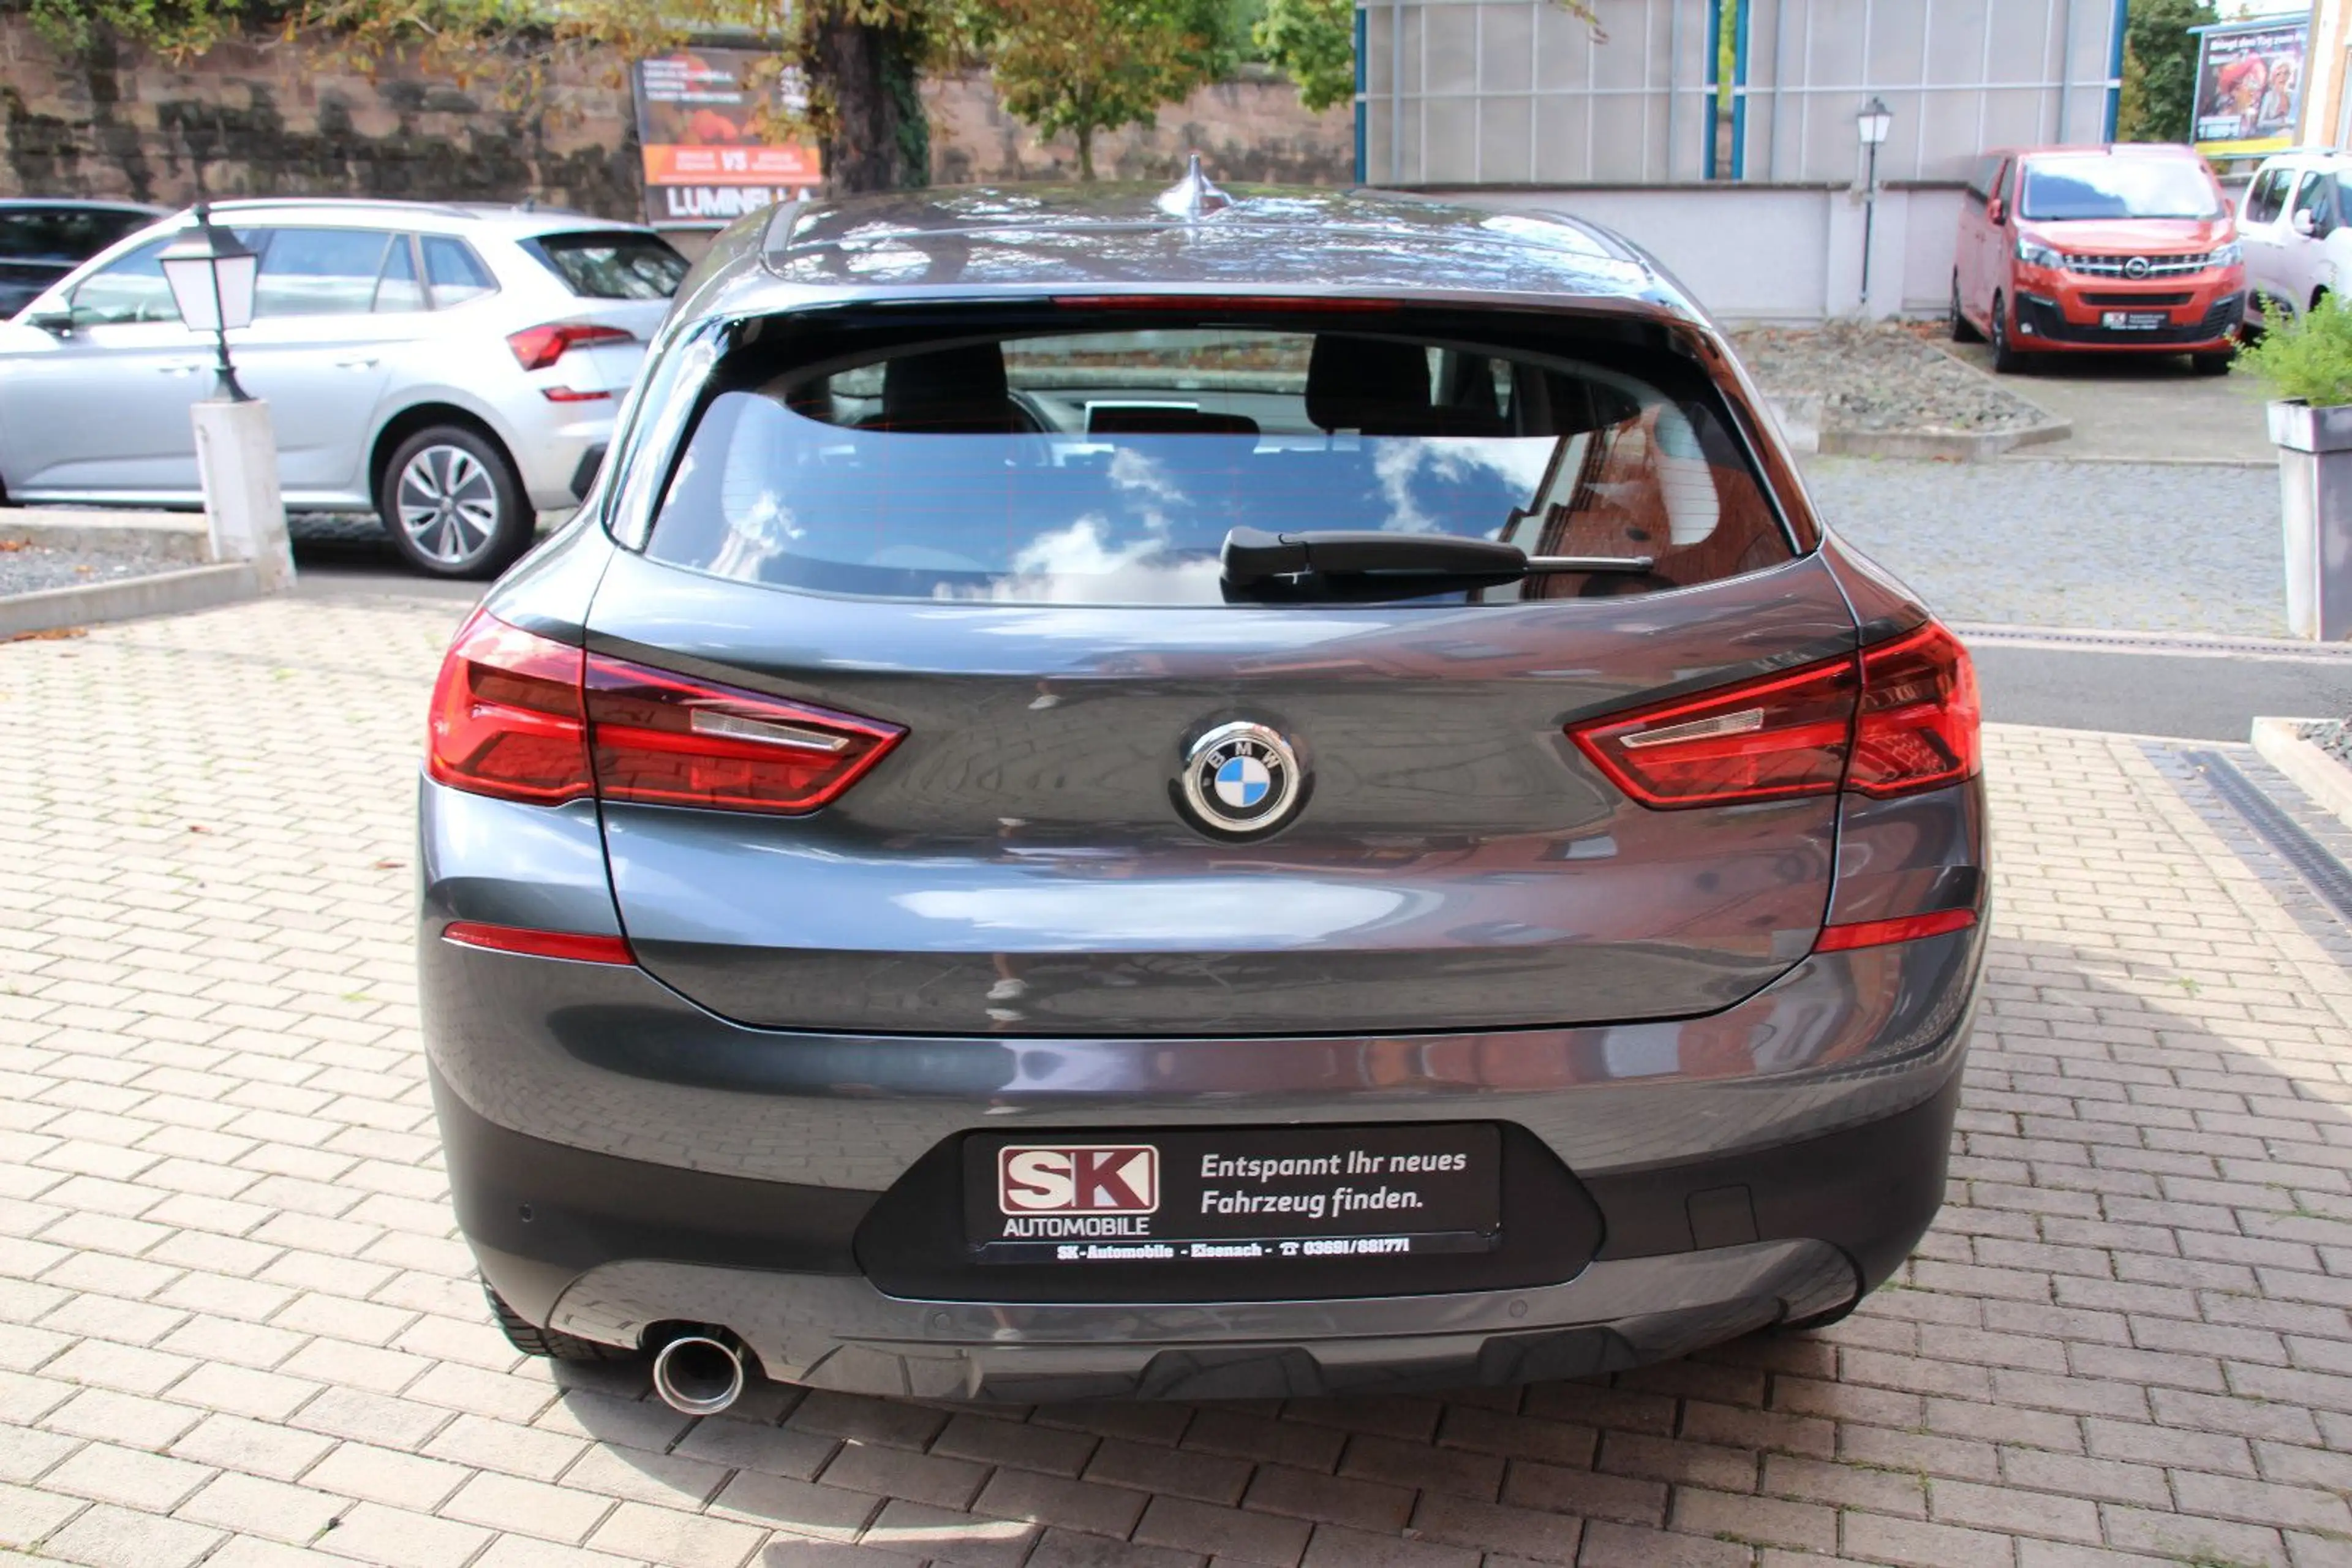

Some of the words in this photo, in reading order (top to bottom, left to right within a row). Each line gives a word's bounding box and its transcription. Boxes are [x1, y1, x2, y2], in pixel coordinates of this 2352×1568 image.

[1205, 741, 1281, 769] BMW
[1007, 1150, 1150, 1209] SK
[1201, 1154, 1341, 1183] Entspannt
[1346, 1150, 1384, 1174] Ihr
[1389, 1153, 1466, 1172] neues
[1201, 1190, 1325, 1218] Fahrzeug
[1332, 1186, 1423, 1218] finden.
[1002, 1216, 1150, 1237] AUTOMOBILE
[1190, 1243, 1262, 1258] Eisenach
